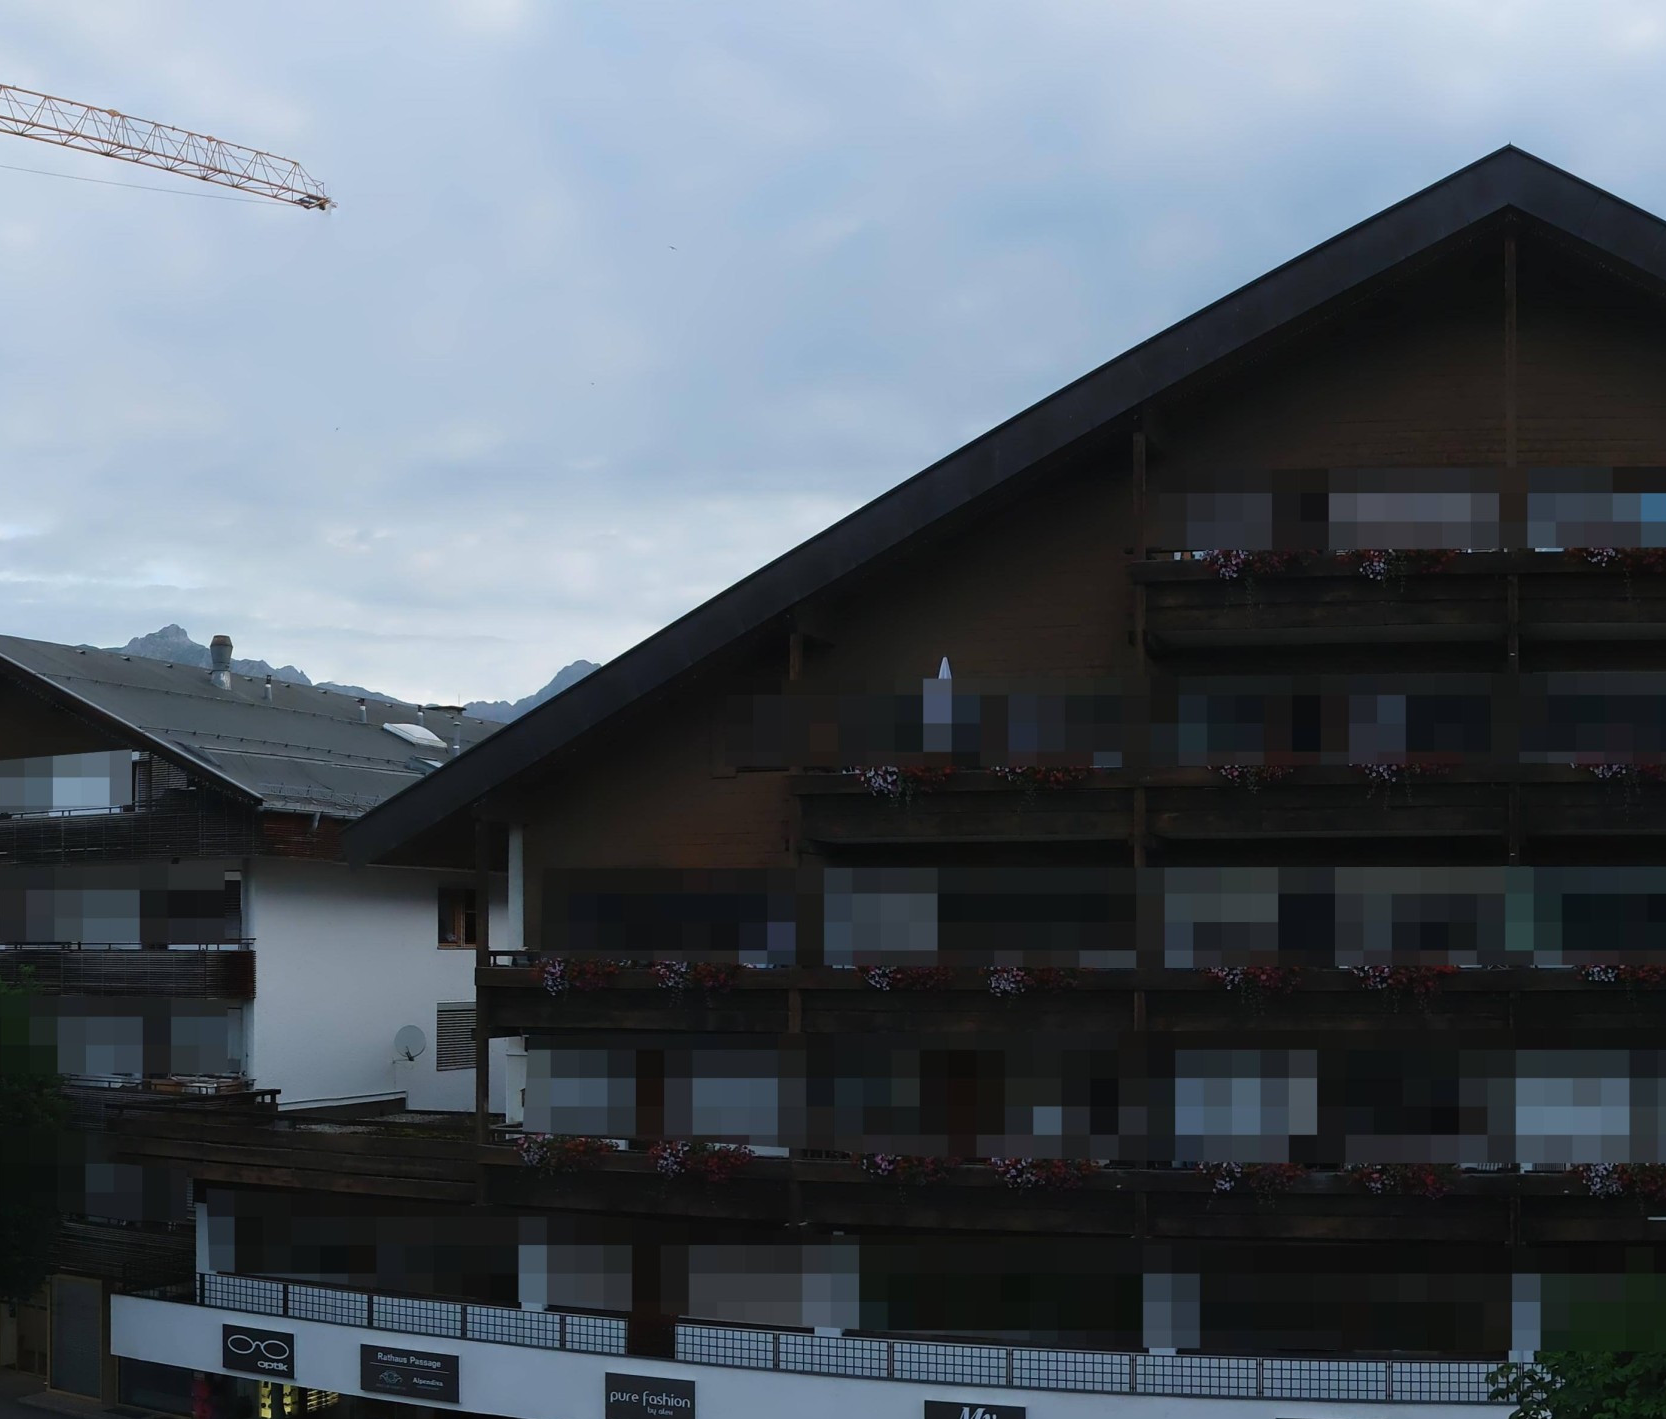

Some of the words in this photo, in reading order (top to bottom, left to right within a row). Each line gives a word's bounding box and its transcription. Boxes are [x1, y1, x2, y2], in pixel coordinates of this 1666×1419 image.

[257, 1359, 289, 1372] optik
[377, 1352, 407, 1364] Rathaus
[409, 1356, 442, 1369] Passage
[609, 1390, 639, 1404] pure
[642, 1390, 691, 1409] fashion
[647, 1406, 657, 1416] by
